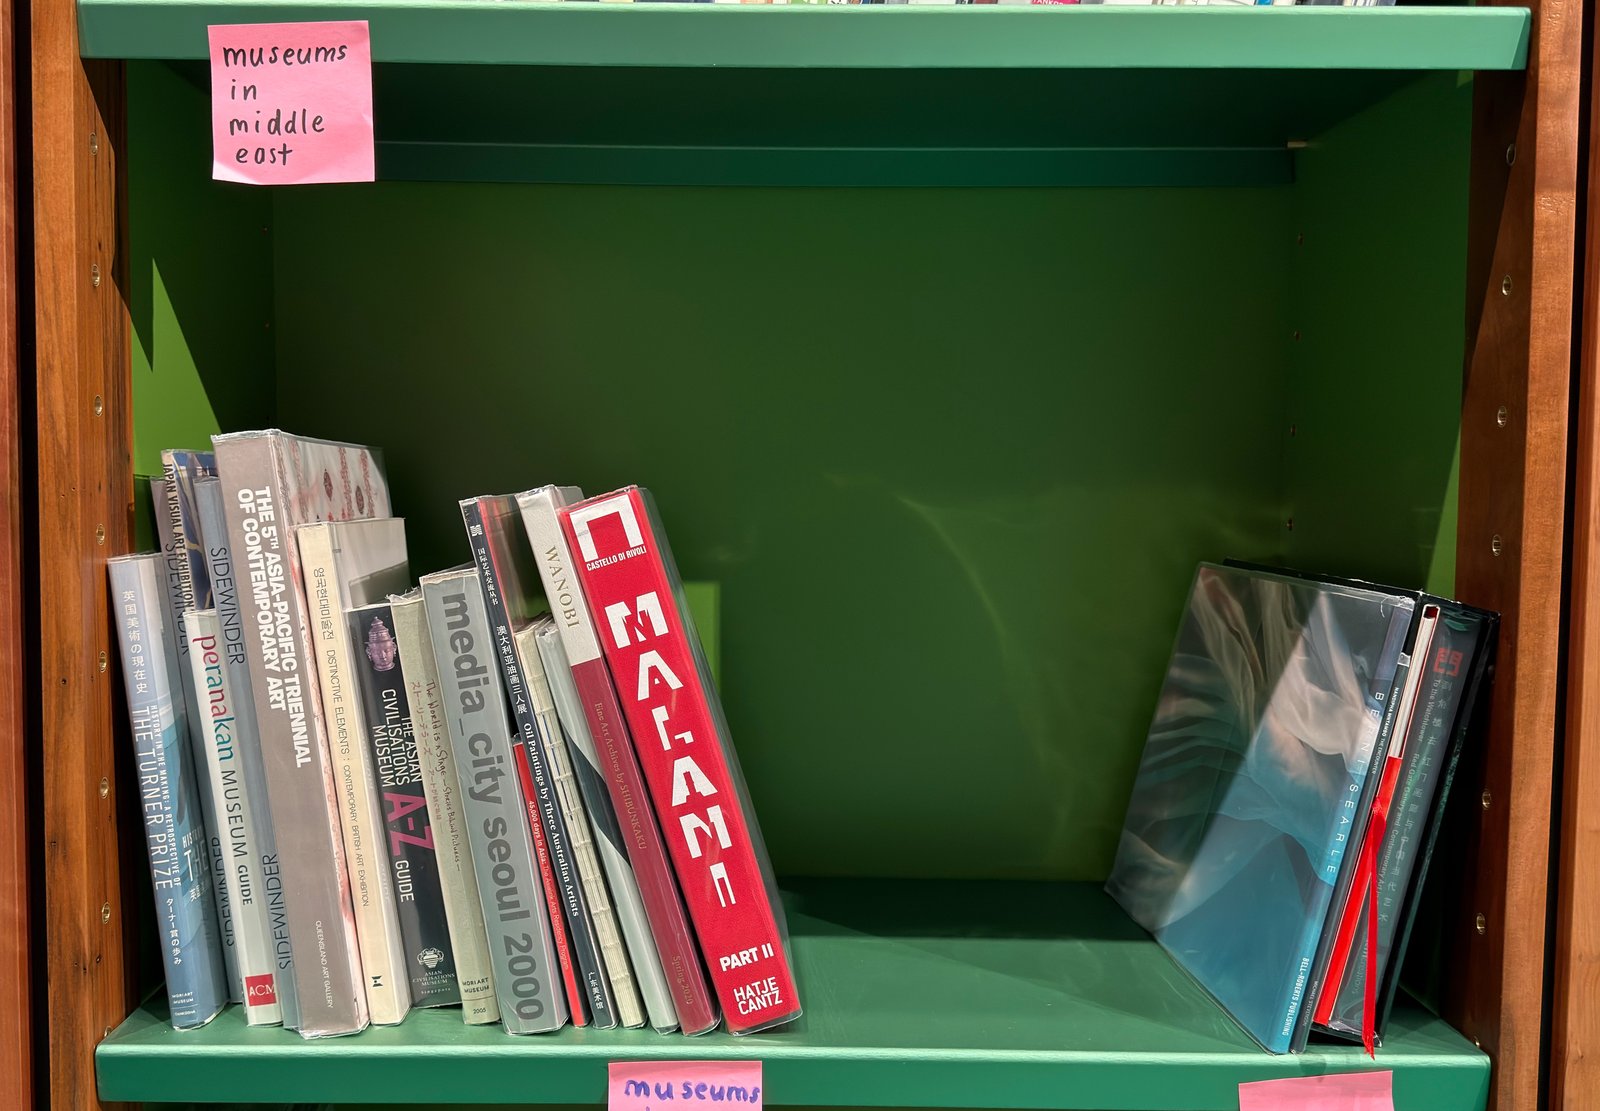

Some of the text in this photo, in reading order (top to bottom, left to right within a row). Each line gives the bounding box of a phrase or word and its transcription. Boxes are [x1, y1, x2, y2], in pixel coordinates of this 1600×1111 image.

[223, 45, 347, 67] museums
[231, 79, 257, 100] in
[230, 108, 325, 136] middle
[236, 143, 293, 165] east
[163, 463, 176, 493] JAPAN
[167, 496, 182, 529] VISUAL
[172, 531, 185, 551] ART
[586, 545, 647, 571] CASTELLO DI RIVOLI
[237, 488, 287, 711] OF CONTEMPORARY ART
[545, 545, 580, 628] WANOBI
[210, 547, 246, 665] SIDEWINDER
[255, 486, 275, 522] THE
[265, 551, 297, 672] ASIA-PACIFIC
[284, 674, 312, 768] TRIENNIAL
[326, 650, 342, 702] DISTINCTIVE
[1432, 679, 1440, 687] To
[1430, 688, 1438, 698] the
[151, 705, 162, 737] HISTORY
[594, 702, 604, 721] Fine
[1419, 699, 1434, 742] Watchtower
[334, 707, 350, 754] ELEMENTS
[382, 689, 410, 785] CIVILISATIONS
[601, 721, 610, 736] Art
[155, 740, 162, 749] IN
[156, 751, 166, 766] THE
[372, 725, 395, 787] MUSEUM
[402, 717, 422, 782] THE ASIAN
[605, 736, 621, 773] Archives
[192, 635, 253, 905] peranakan MUSEUM GUIDE
[1411, 753, 1419, 766] Red
[615, 773, 624, 784] by
[1407, 768, 1416, 784] Gate
[132, 706, 173, 890] THE TURNER PRIZE
[343, 764, 358, 821] CONTEMPORARY
[1397, 786, 1411, 812] Gallery
[523, 722, 579, 917] Oil Paintings by Three Australian Artists
[531, 822, 541, 840] days
[1327, 784, 1359, 873] SEARLE
[1394, 811, 1403, 826] and
[165, 813, 181, 875] RETROSPECTIVE
[352, 825, 362, 850] BRITISH
[384, 792, 434, 902] A-Z GUIDE
[356, 853, 364, 866] ART
[1379, 829, 1398, 878] Contemporary
[173, 877, 181, 886] OF
[483, 817, 530, 922] seoul
[358, 870, 369, 907] EXHIBITION
[315, 920, 334, 1009] QUEENSLAND ART GALLERY
[671, 955, 687, 983] Spring
[720, 943, 774, 972] PART II
[249, 983, 276, 996] ACM
[464, 985, 489, 993] MUSEUM
[504, 933, 544, 1020] 2000
[734, 976, 779, 1002] HATJE
[737, 990, 783, 1016] CANTZ
[1282, 957, 1309, 1036] BELL-ROBERTS PUBLISHING
[624, 1079, 760, 1104] museums
